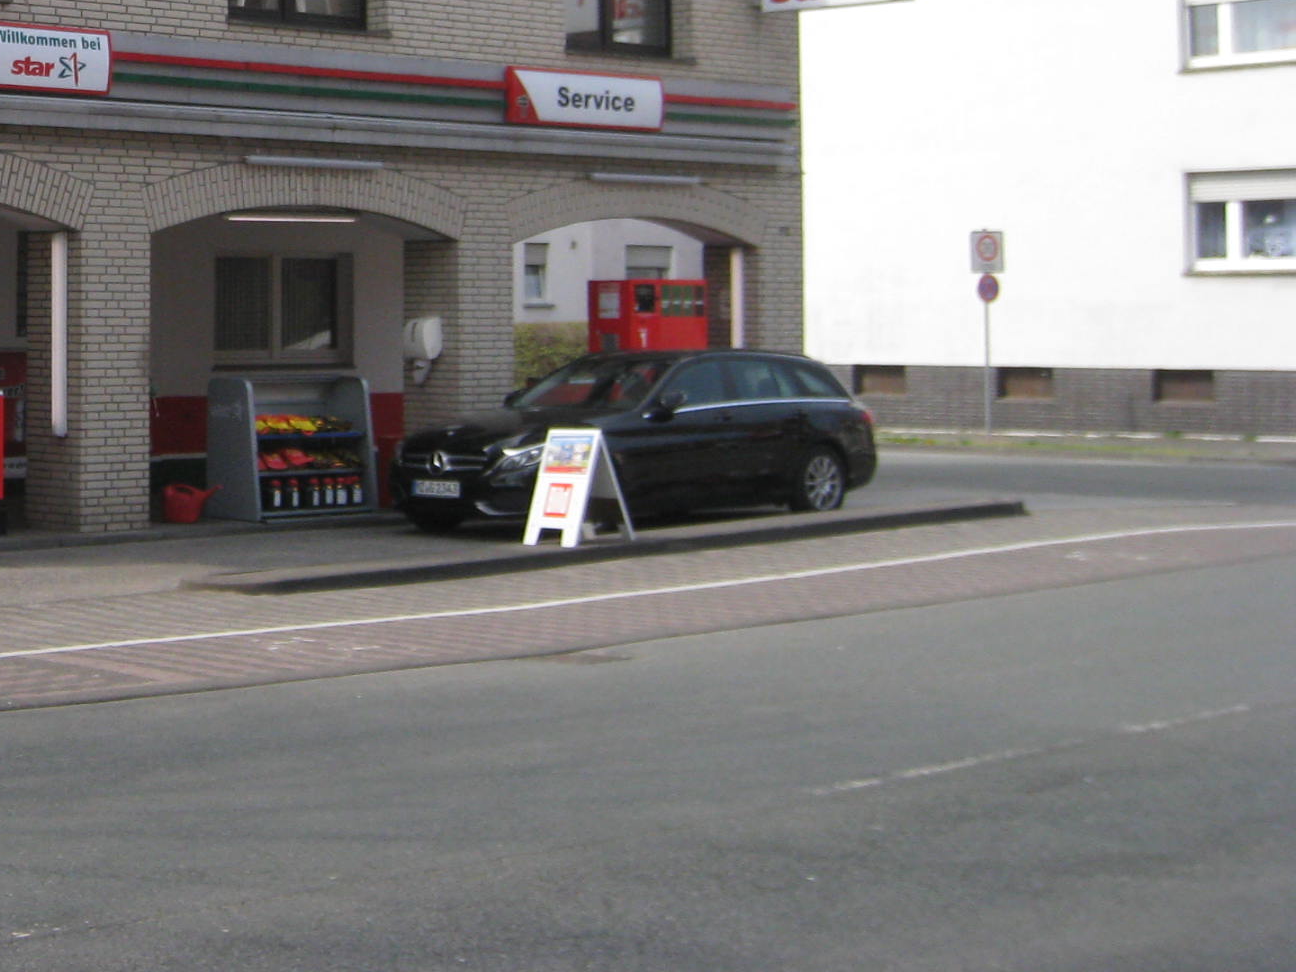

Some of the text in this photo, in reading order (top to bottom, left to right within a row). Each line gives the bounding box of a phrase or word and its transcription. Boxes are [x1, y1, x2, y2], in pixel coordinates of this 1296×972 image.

[81, 37, 101, 51] bei
[11, 56, 56, 77] star
[557, 86, 635, 112] Service
